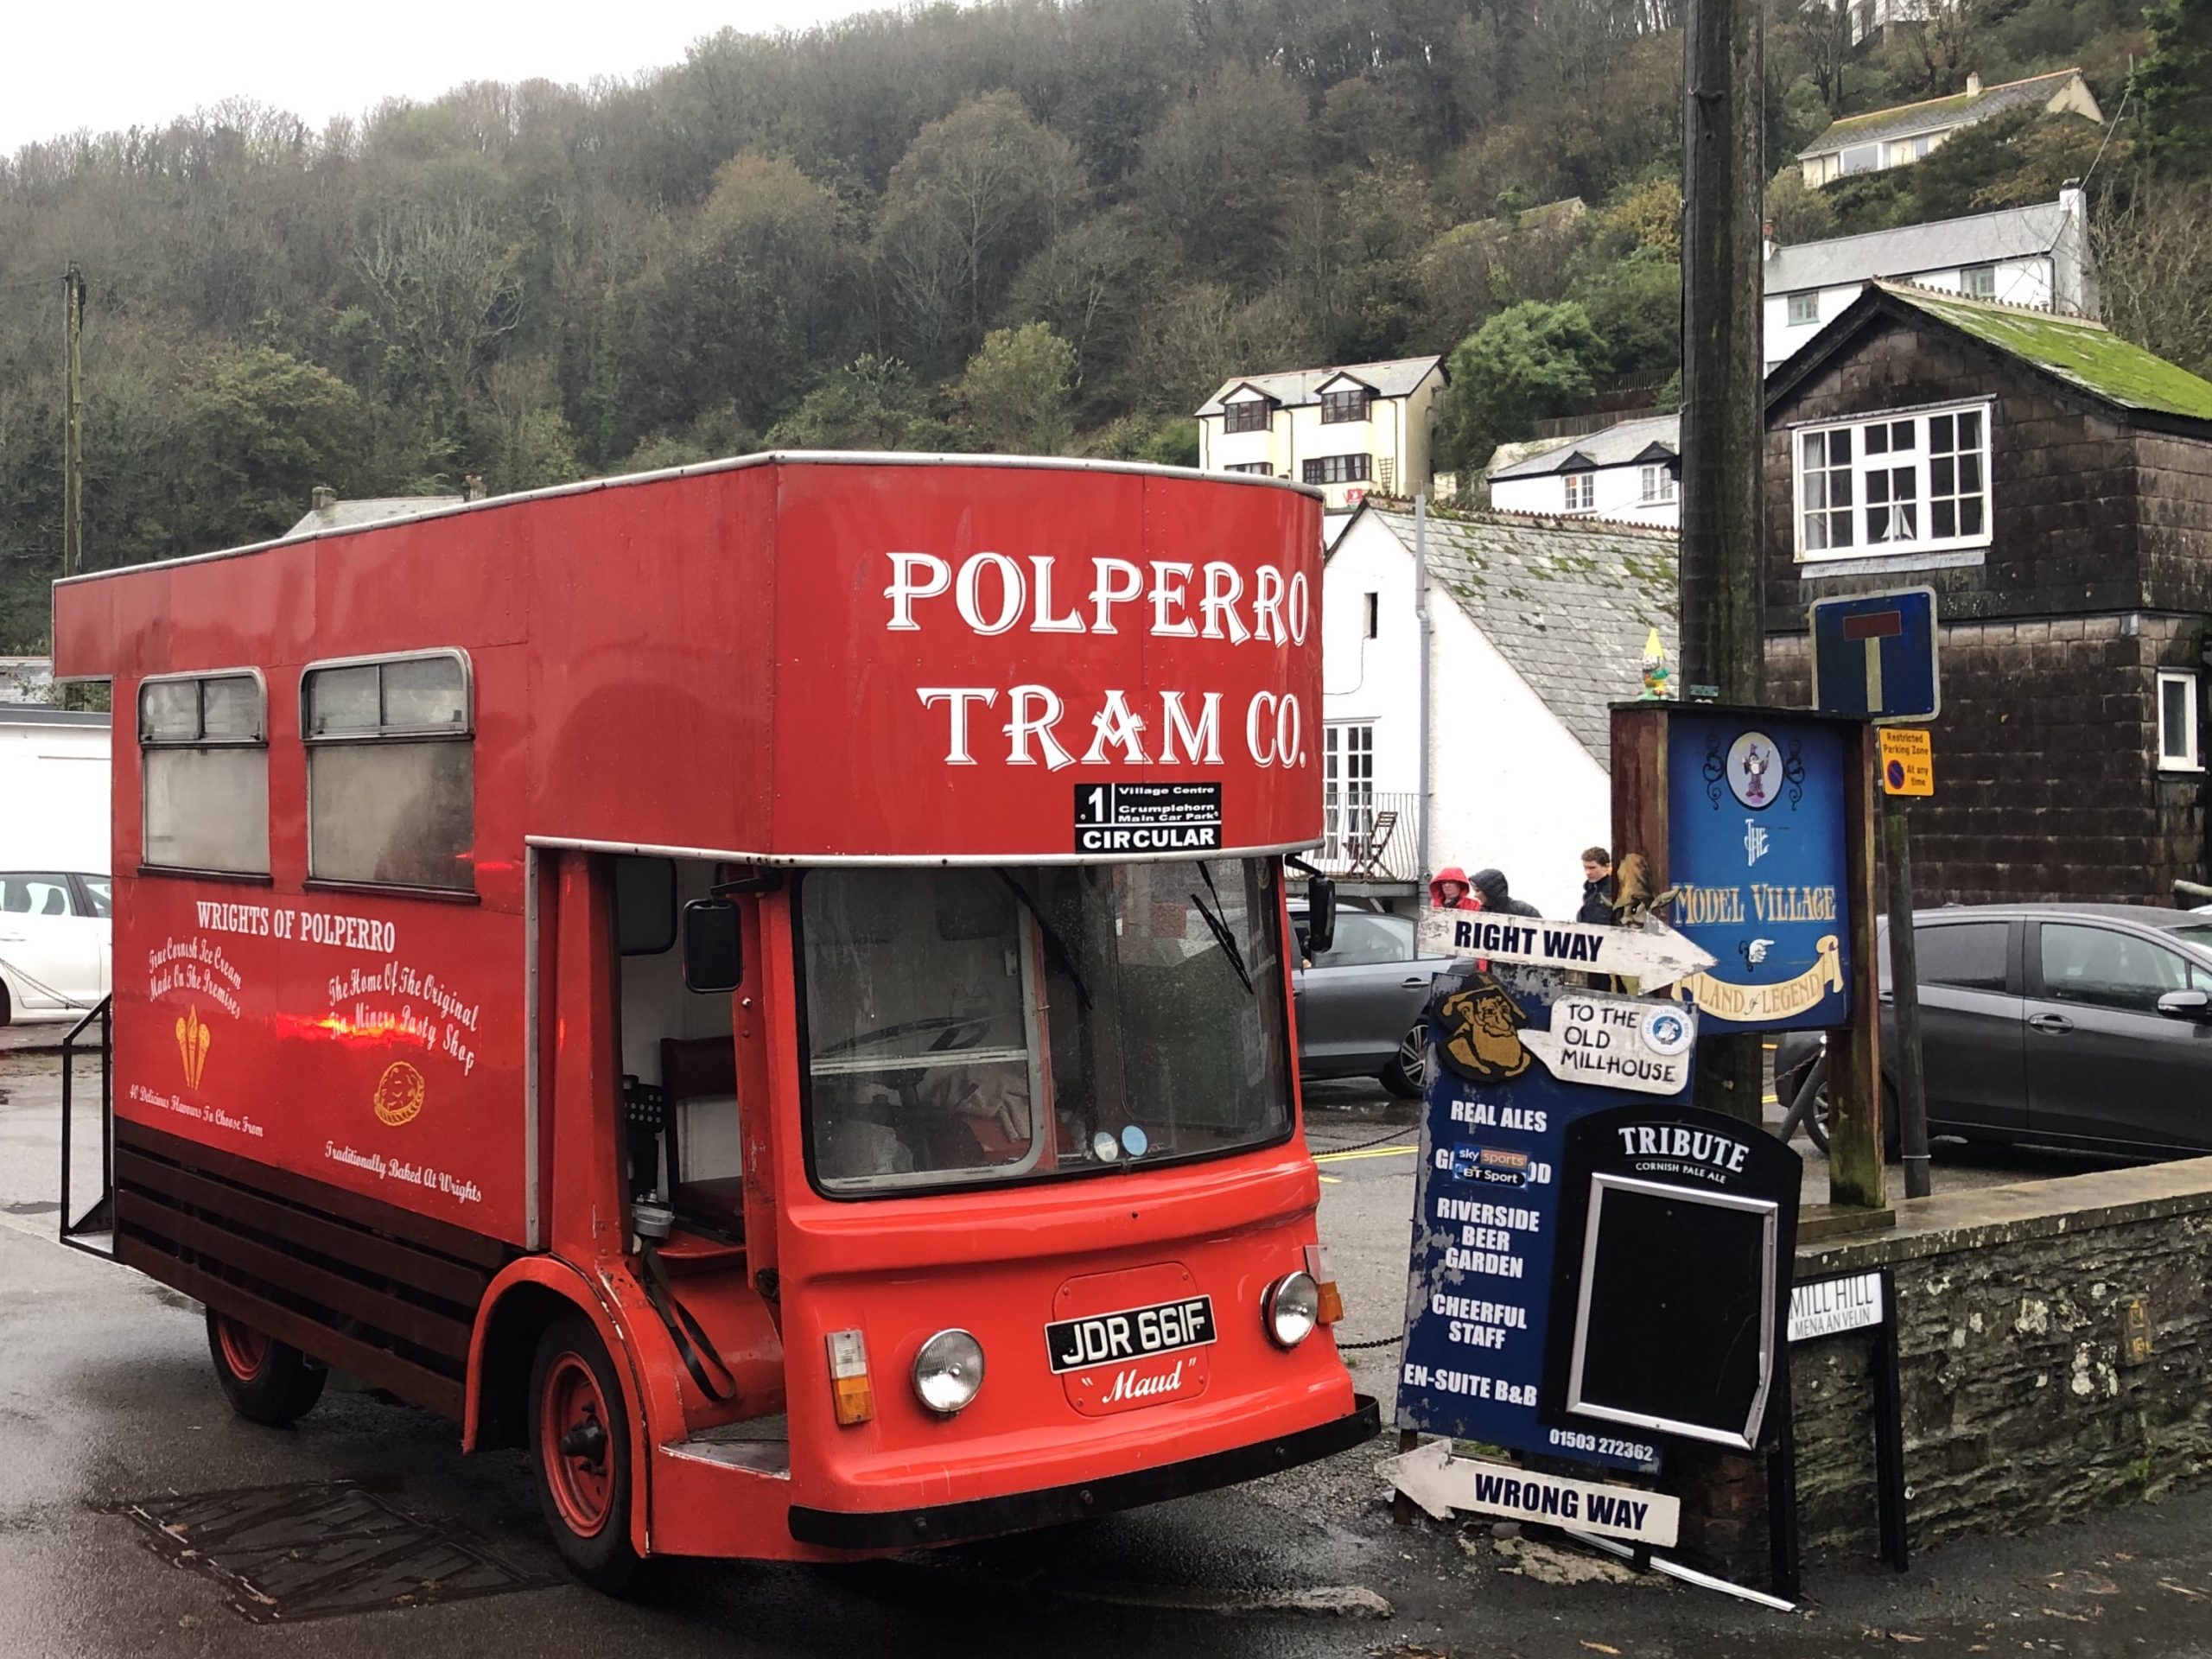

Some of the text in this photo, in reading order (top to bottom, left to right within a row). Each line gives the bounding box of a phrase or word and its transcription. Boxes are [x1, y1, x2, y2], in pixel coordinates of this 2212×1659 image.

[883, 552, 1309, 648] POLPERRO
[916, 684, 1307, 772] TRAM CO.
[1887, 732, 1923, 743] Restricted
[1884, 743, 1929, 756] Parking Zone
[1088, 786, 1103, 823] 1
[1118, 786, 1169, 796] Village
[1118, 804, 1215, 814] Crumplehorn
[1185, 811, 1214, 820] Park
[1083, 828, 1216, 849] CIRCULAR
[1744, 818, 1770, 867] THE
[1671, 882, 1837, 925] MODEL VILLAGE
[196, 900, 396, 954] WRIGHTS OF POLPERRO
[1453, 920, 1604, 963] RIGHT WAY
[149, 935, 241, 990] True Cornish Ice Cream
[149, 963, 241, 1020] Made On The Premises
[328, 960, 480, 1032] The Home Of The Original
[1699, 973, 1821, 1016] LAND of LEGEND
[1567, 1003, 1640, 1029] TO THE
[351, 1001, 396, 1034] Miners
[400, 1004, 437, 1051] Pasty
[442, 1023, 475, 1077] Shop
[1564, 1026, 1611, 1049] OLD
[1560, 1048, 1676, 1083] MILLHOUSE
[139, 1085, 169, 1109] Delicious
[170, 1095, 202, 1119] Flavours
[202, 1105, 214, 1122] To
[215, 1108, 241, 1130] Choose
[242, 1116, 264, 1137] From
[1450, 1099, 1548, 1133] REAL ALES
[1459, 1148, 1480, 1162] sky
[1483, 1152, 1524, 1166] sports
[1618, 1126, 1750, 1173] TRIBUTE
[324, 1140, 482, 1204] Traditionally Baked At Wrights
[1463, 1166, 1519, 1185] BT Sport
[1635, 1162, 1726, 1184] CORNISH PALE ALE
[1436, 1197, 1541, 1232] RIVERSIDE
[1461, 1225, 1511, 1252] BEER
[1445, 1246, 1523, 1279] GARDEN
[1431, 1293, 1528, 1330] CHEERFUL
[1789, 1274, 1874, 1319] MILL HILL
[1062, 1301, 1206, 1365] JDR 661F
[1448, 1320, 1507, 1350] STAFF
[1794, 1306, 1871, 1338] MENA AN VELIN
[1403, 1363, 1538, 1408] EN-SUITE B&B
[1548, 1428, 1654, 1462] 01503 272362
[1475, 1473, 1649, 1531] WRONG WAY
